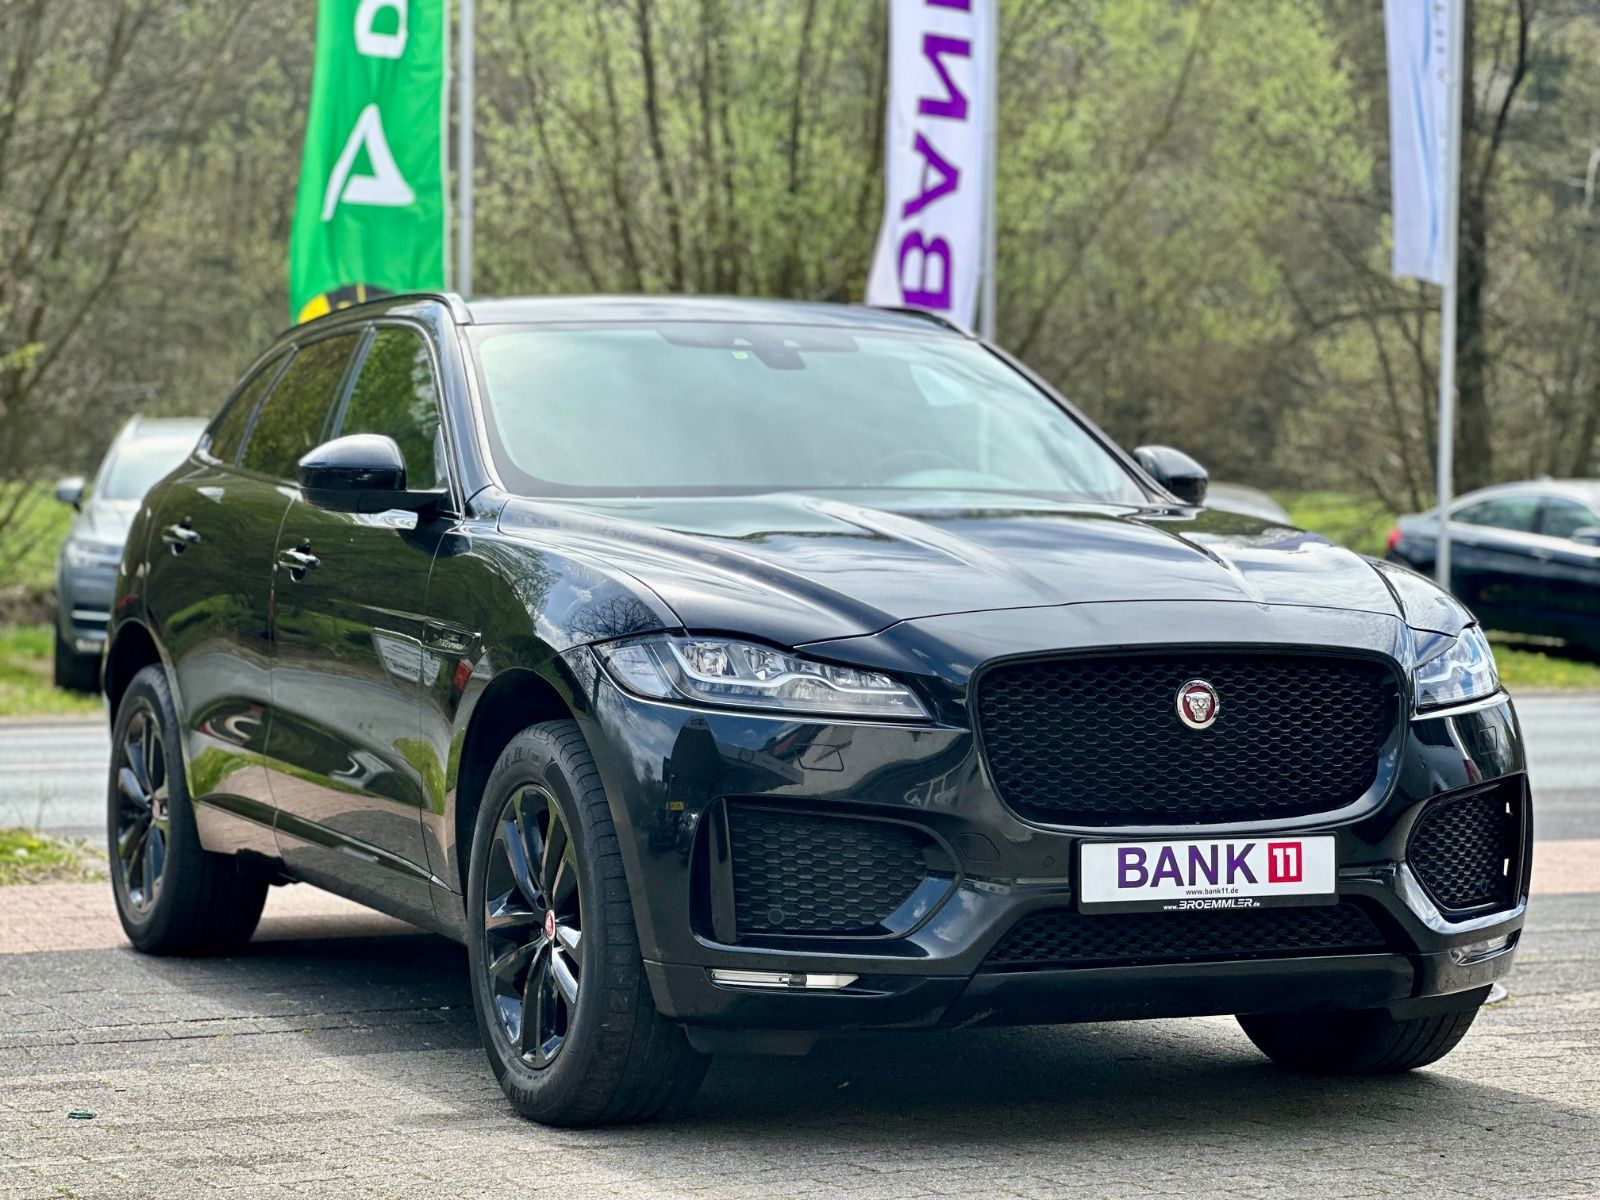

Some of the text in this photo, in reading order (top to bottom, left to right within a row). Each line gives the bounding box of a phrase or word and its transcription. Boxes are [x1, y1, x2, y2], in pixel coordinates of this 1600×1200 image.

[1118, 843, 1297, 888] BANK 11
[1185, 887, 1239, 896] www.bank11.de
